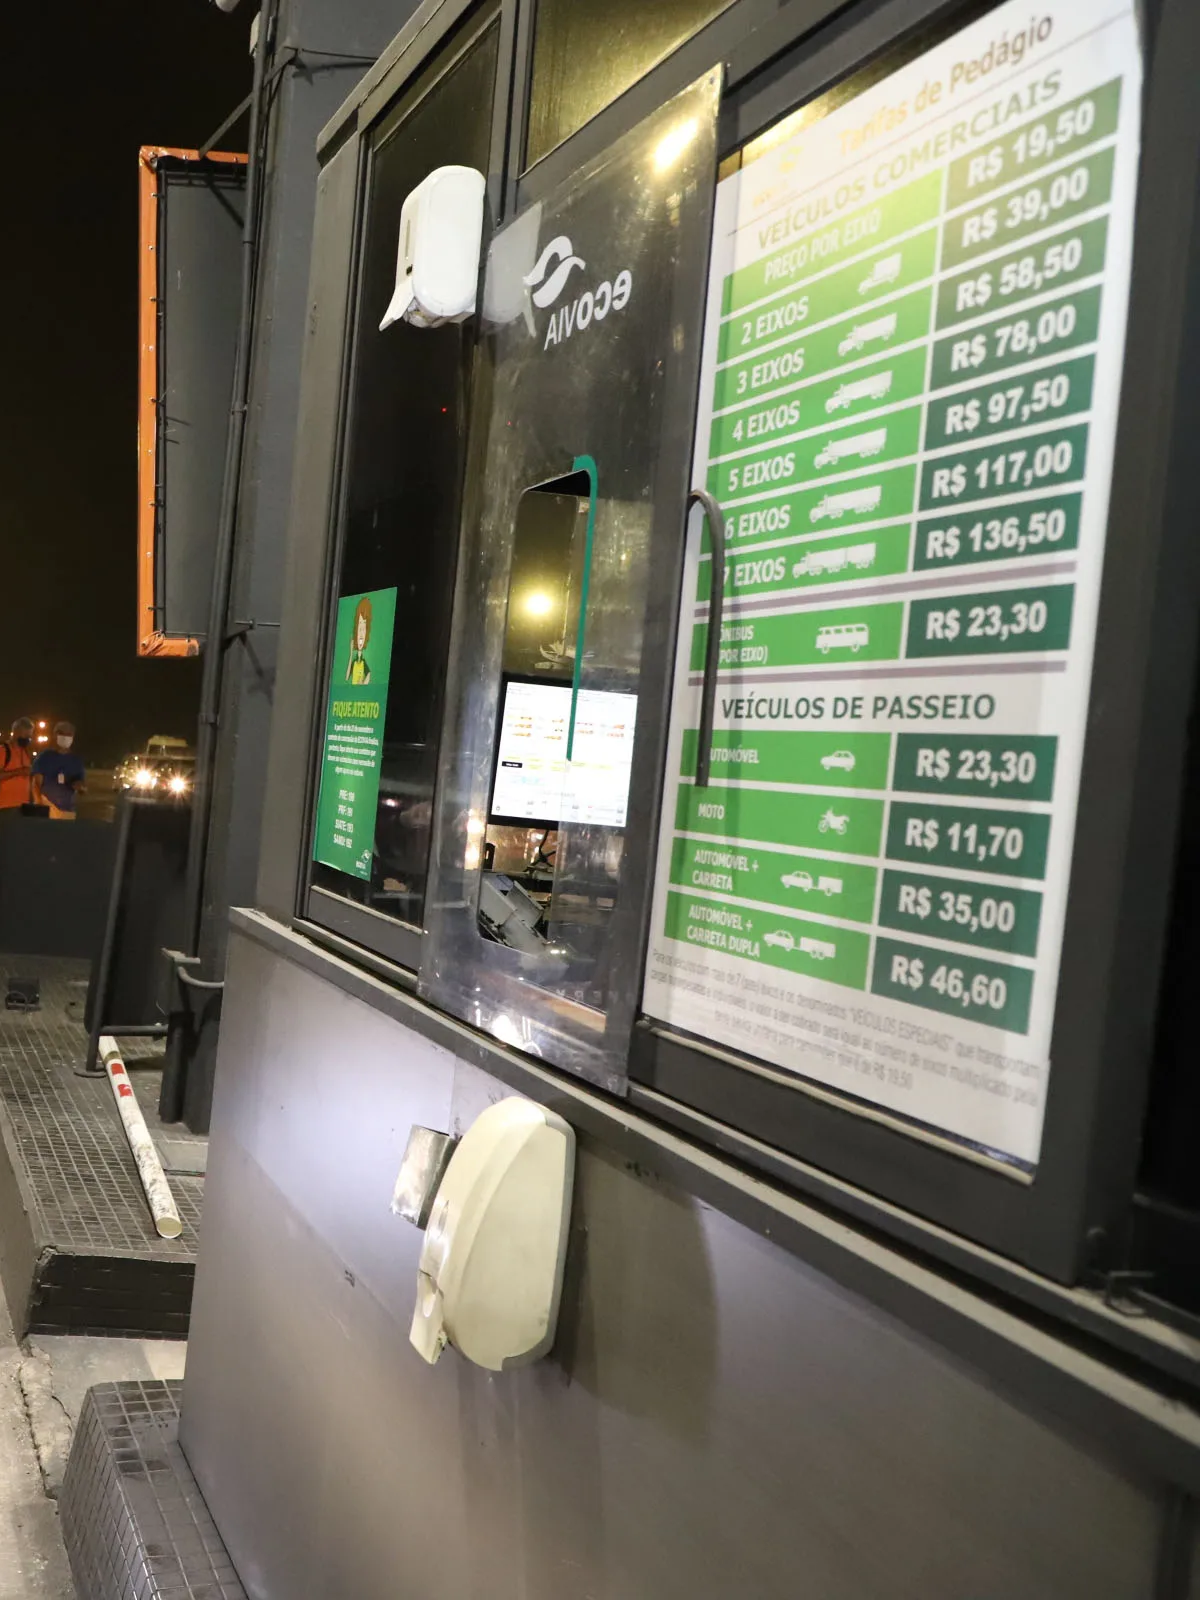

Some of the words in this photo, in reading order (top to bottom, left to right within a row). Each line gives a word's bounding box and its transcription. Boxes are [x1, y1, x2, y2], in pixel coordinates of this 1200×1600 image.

[914, 78, 941, 114] de
[950, 14, 1053, 94] Pedágio
[758, 177, 866, 250] VEÍCULOS
[873, 69, 1062, 190] COMERCIAIS
[967, 145, 1003, 189] R$
[1014, 99, 1095, 166] 19,50
[961, 208, 997, 248] R$
[1006, 167, 1088, 229] 39,00
[764, 244, 808, 284] PREÇO
[810, 228, 841, 264] POR
[843, 210, 883, 249] EIXO
[955, 275, 992, 312] R$
[999, 239, 1082, 296] 58,50
[741, 322, 751, 344] 2
[755, 295, 809, 339] EIXOS
[952, 335, 986, 371] R$
[995, 305, 1076, 357] 78,00
[736, 372, 747, 394] 3
[751, 348, 805, 389] EIXOS
[732, 420, 743, 441] 4
[747, 400, 800, 438] EIXOS
[946, 399, 980, 435] R$
[988, 374, 1069, 422] 97,50
[729, 469, 739, 492] 5
[743, 453, 795, 489] EIXOS
[932, 464, 967, 498] R$
[975, 441, 1072, 488] 117,00
[724, 517, 735, 540] 6
[738, 504, 791, 537] EIXOS
[926, 527, 961, 560] R$
[969, 509, 1066, 552] 136,50
[734, 556, 786, 587] EIXOS
[925, 610, 960, 641] R$
[967, 601, 1046, 641] 23,30
[718, 648, 739, 664] POR
[332, 702, 352, 718] FIQUE
[352, 702, 380, 718] ATENTO
[722, 691, 824, 719] VEÍCULOS
[833, 696, 864, 719] DE
[872, 693, 996, 720] PASSEIO
[709, 744, 760, 764] UTOMÓVEL
[916, 748, 950, 782] R$
[957, 749, 1036, 786] 23,30
[698, 803, 725, 820] MOTO
[694, 848, 750, 873] AUTOMÓVEL
[905, 818, 939, 851] R$
[947, 823, 1023, 861] 11,70
[692, 870, 733, 892] CARRETA
[689, 904, 743, 931] AUTOMÓVEL
[899, 885, 932, 918] R$
[939, 889, 1015, 932] 35,00
[687, 925, 727, 950] CARRETA
[729, 932, 760, 959] DUPLA
[891, 955, 923, 991] R$
[929, 966, 1006, 1009] 46,60
